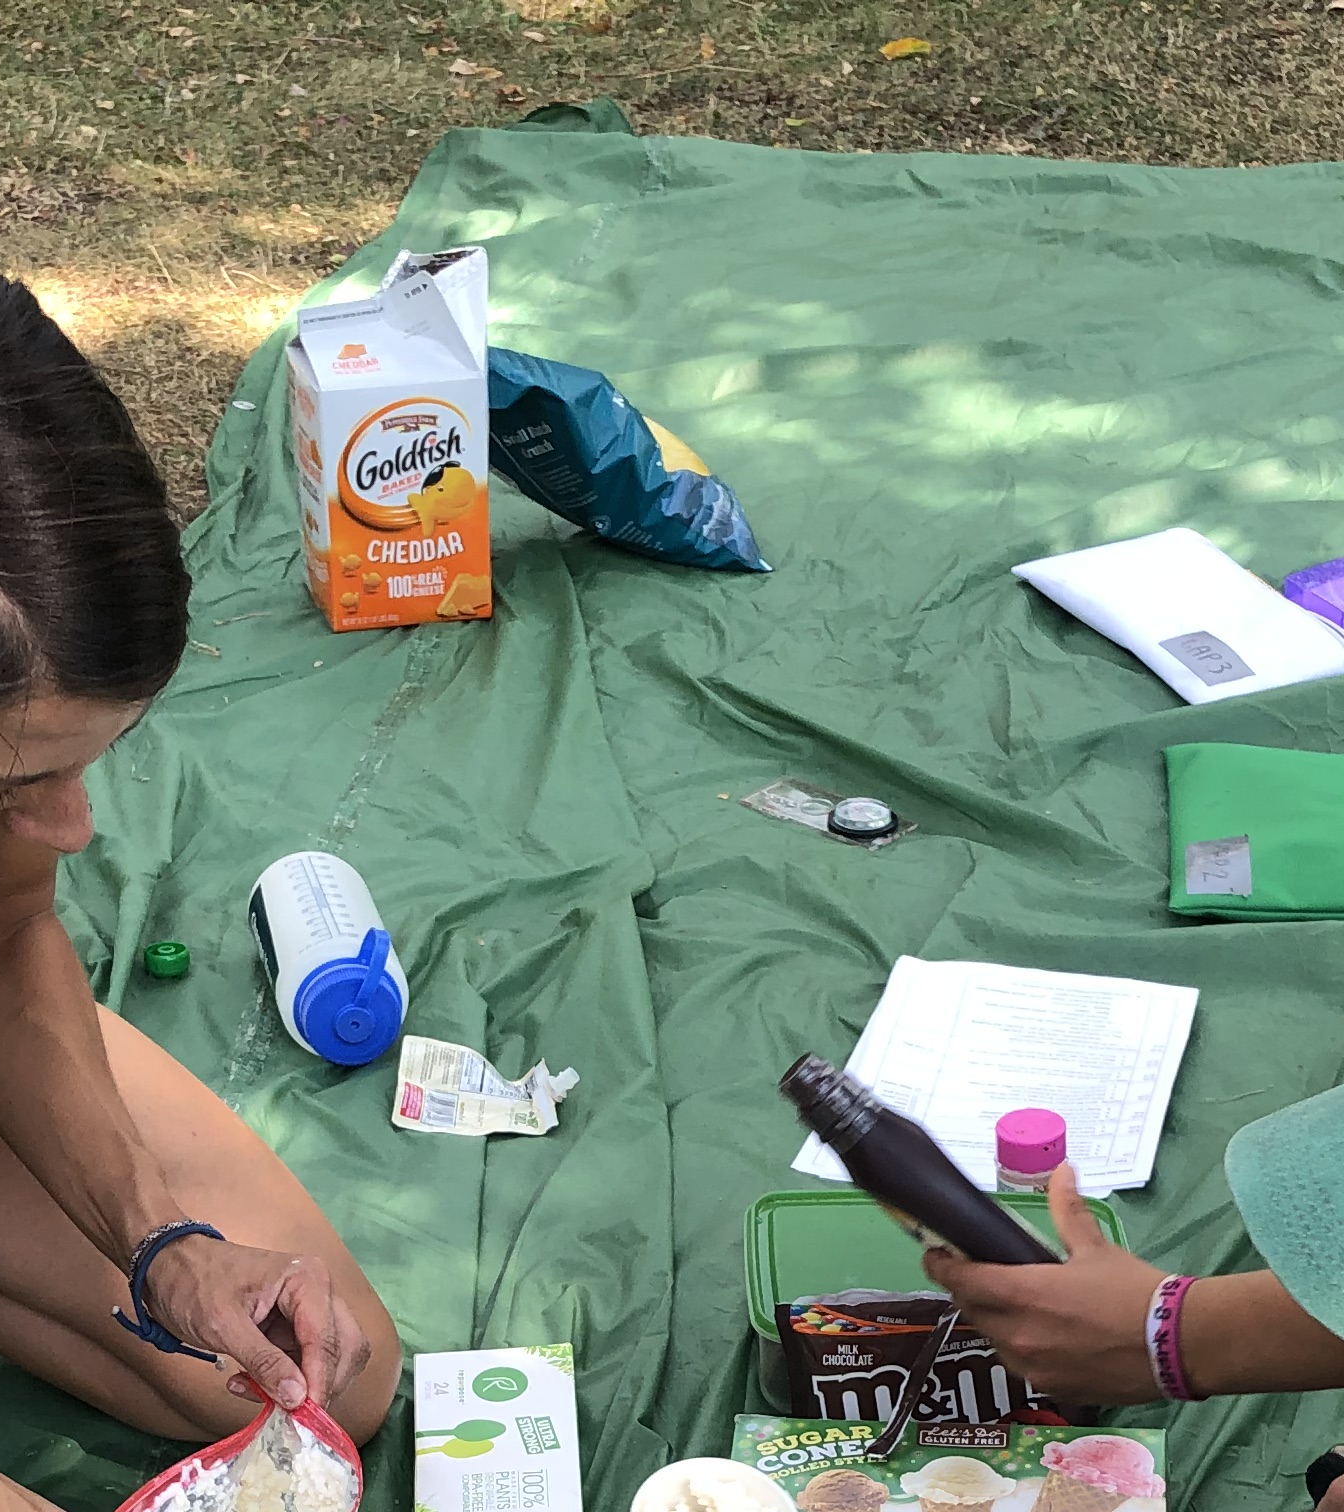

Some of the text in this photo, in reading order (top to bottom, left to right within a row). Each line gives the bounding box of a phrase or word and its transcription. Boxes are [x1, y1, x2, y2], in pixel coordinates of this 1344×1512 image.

[332, 357, 379, 370] CHEDDAR
[356, 426, 462, 490] Goldfish
[382, 472, 423, 494] BAKED
[367, 531, 465, 564] CHEDDAR
[822, 1354, 874, 1367] CHOCOLATE
[837, 1344, 859, 1355] MILK
[434, 1382, 449, 1395] 24
[518, 1418, 541, 1454] STRONG
[537, 1420, 557, 1448] ULTRA
[756, 1425, 873, 1456] SUGAR
[925, 1436, 1001, 1445] GLUTEN FREE
[927, 1426, 973, 1436] Let's
[472, 1474, 483, 1512] BPA-FREE
[496, 1471, 510, 1510] PLANTS
[522, 1469, 545, 1508] 100%
